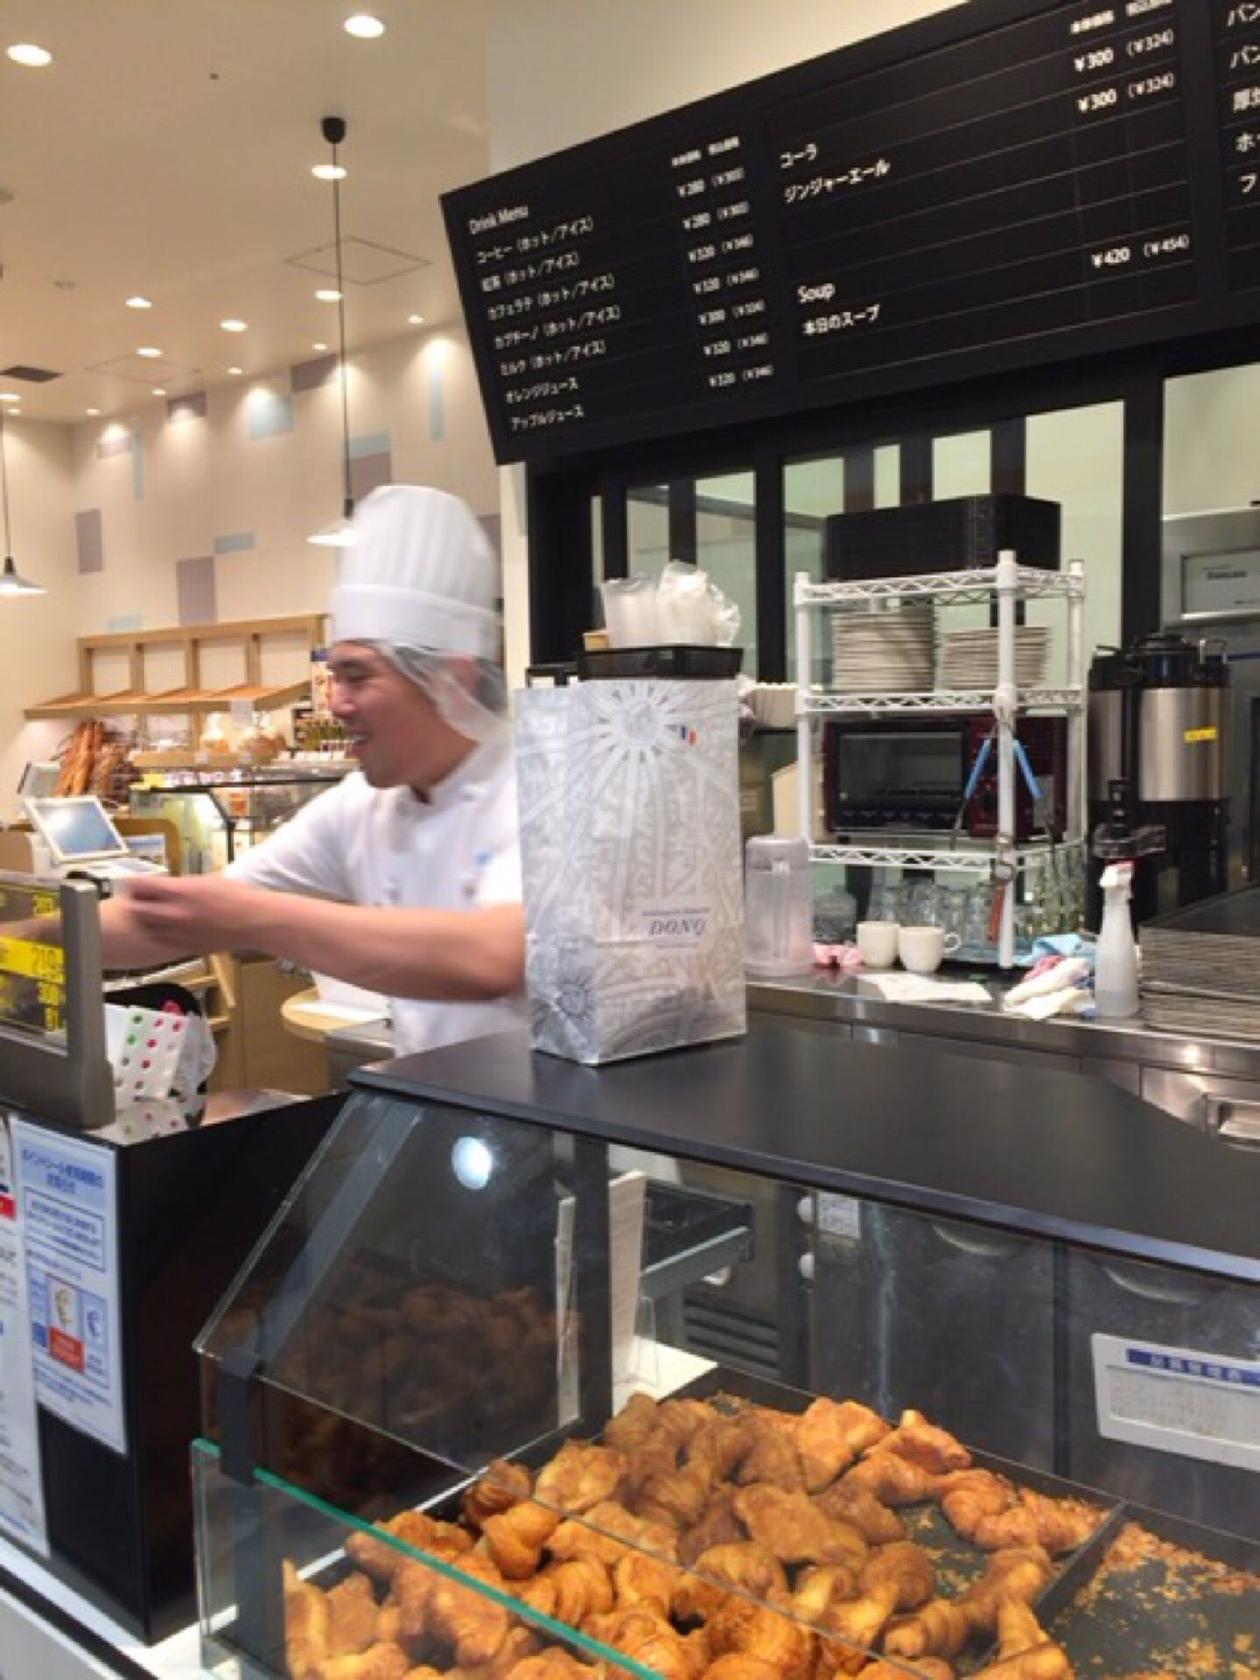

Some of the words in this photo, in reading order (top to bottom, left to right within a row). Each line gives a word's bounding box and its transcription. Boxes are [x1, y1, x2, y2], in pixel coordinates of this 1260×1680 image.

[780, 144, 817, 168] コーラ
[1074, 47, 1114, 72] ¥300
[785, 159, 890, 203] ジンジャーエール
[1076, 88, 1118, 113] ¥300
[798, 283, 835, 303] Soup
[803, 304, 880, 335] 本日のスープ
[1091, 247, 1131, 268] ¥420
